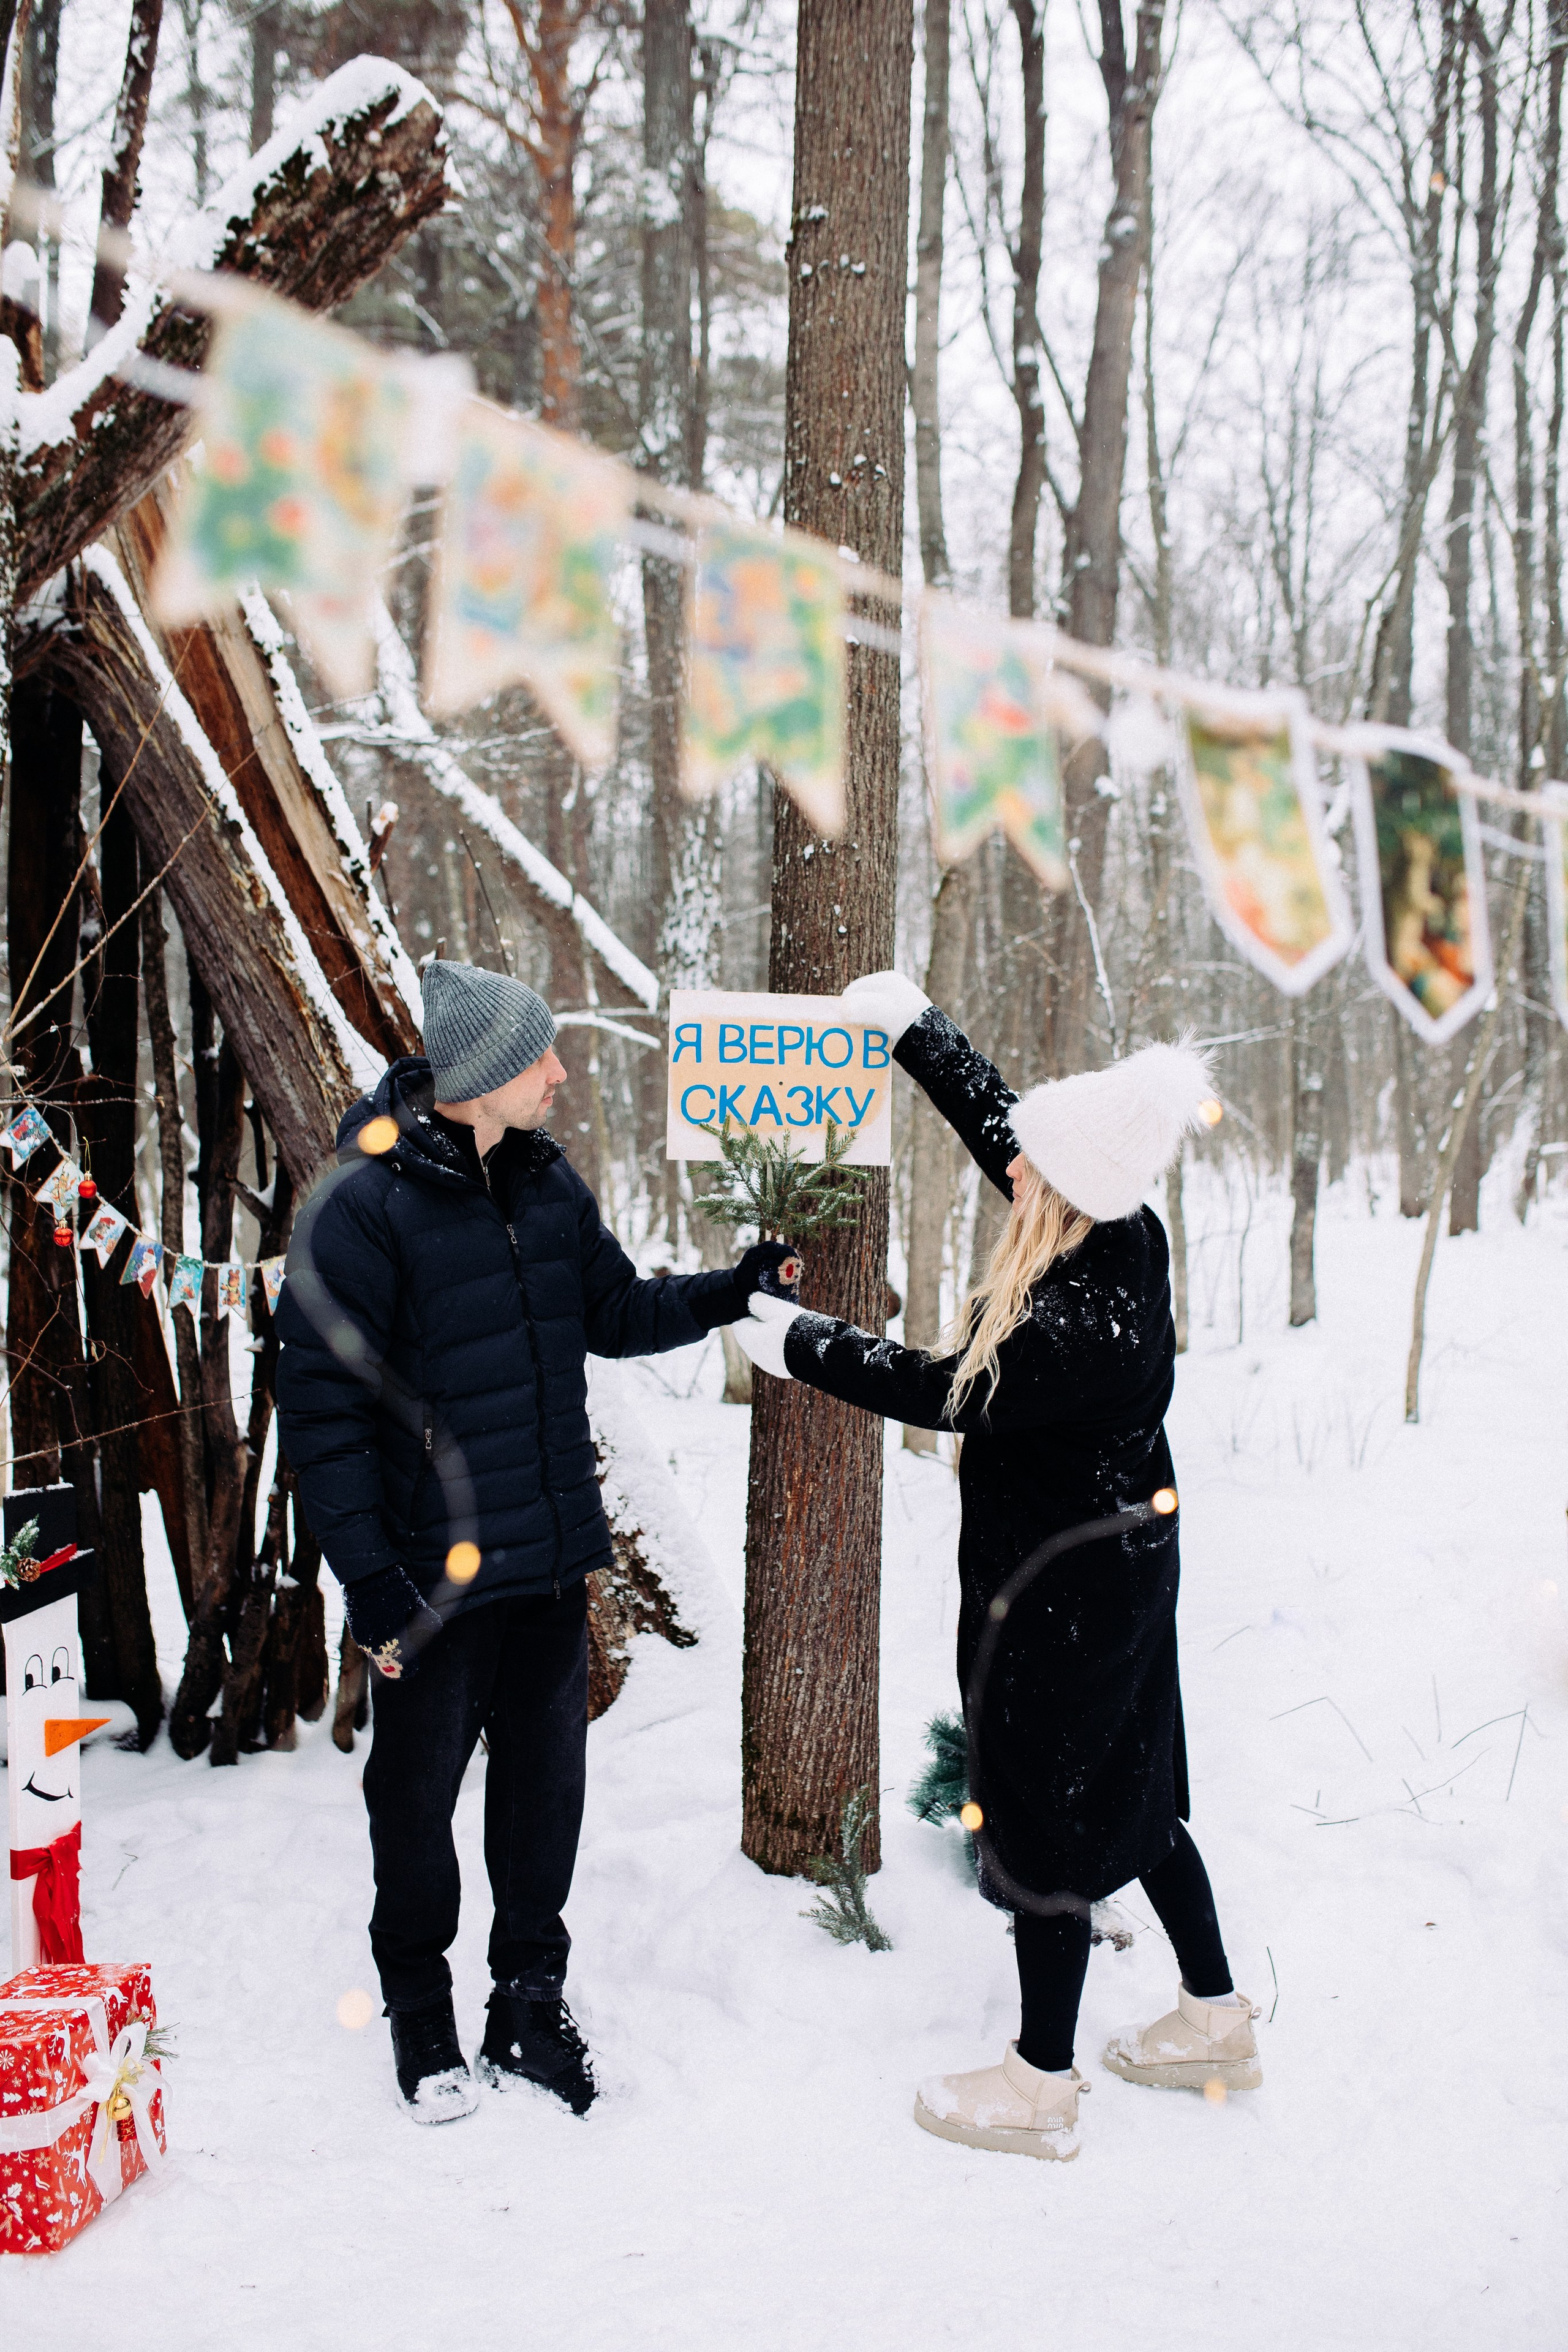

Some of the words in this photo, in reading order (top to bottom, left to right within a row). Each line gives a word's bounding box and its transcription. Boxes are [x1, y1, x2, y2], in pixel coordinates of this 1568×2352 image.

[673, 1023, 702, 1063] Я
[718, 1023, 853, 1068] ВЕРЮ
[863, 1030, 890, 1069] В
[680, 1084, 875, 1127] СКАЗКУ
